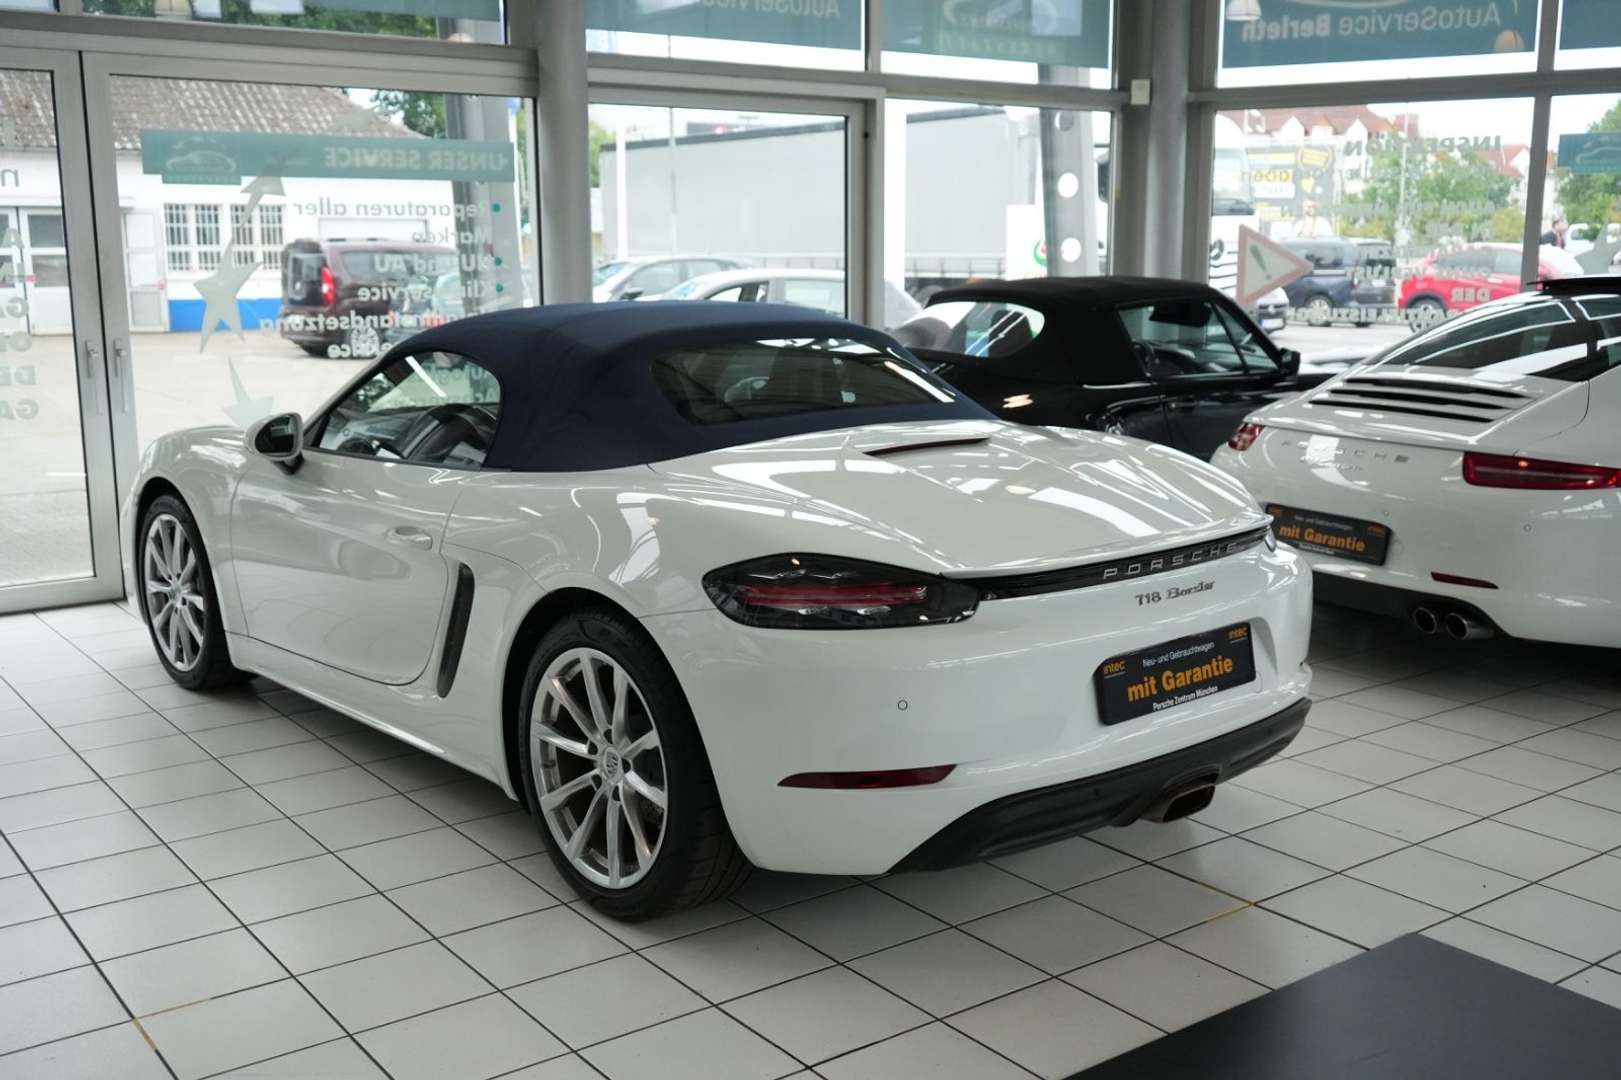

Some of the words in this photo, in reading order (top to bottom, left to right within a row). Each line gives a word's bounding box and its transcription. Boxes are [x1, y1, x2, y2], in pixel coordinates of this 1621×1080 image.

[1279, 524, 1301, 539] mit
[1304, 527, 1366, 552] Garantie
[1103, 543, 1237, 579] PORSCHE
[1135, 592, 1162, 607] 718
[1103, 660, 1126, 675] intec
[1127, 675, 1158, 702] mit
[1162, 656, 1233, 692] Garantie
[1152, 698, 1174, 712] Porsche
[1174, 691, 1196, 706] Zentrum
[1195, 685, 1219, 699] München
